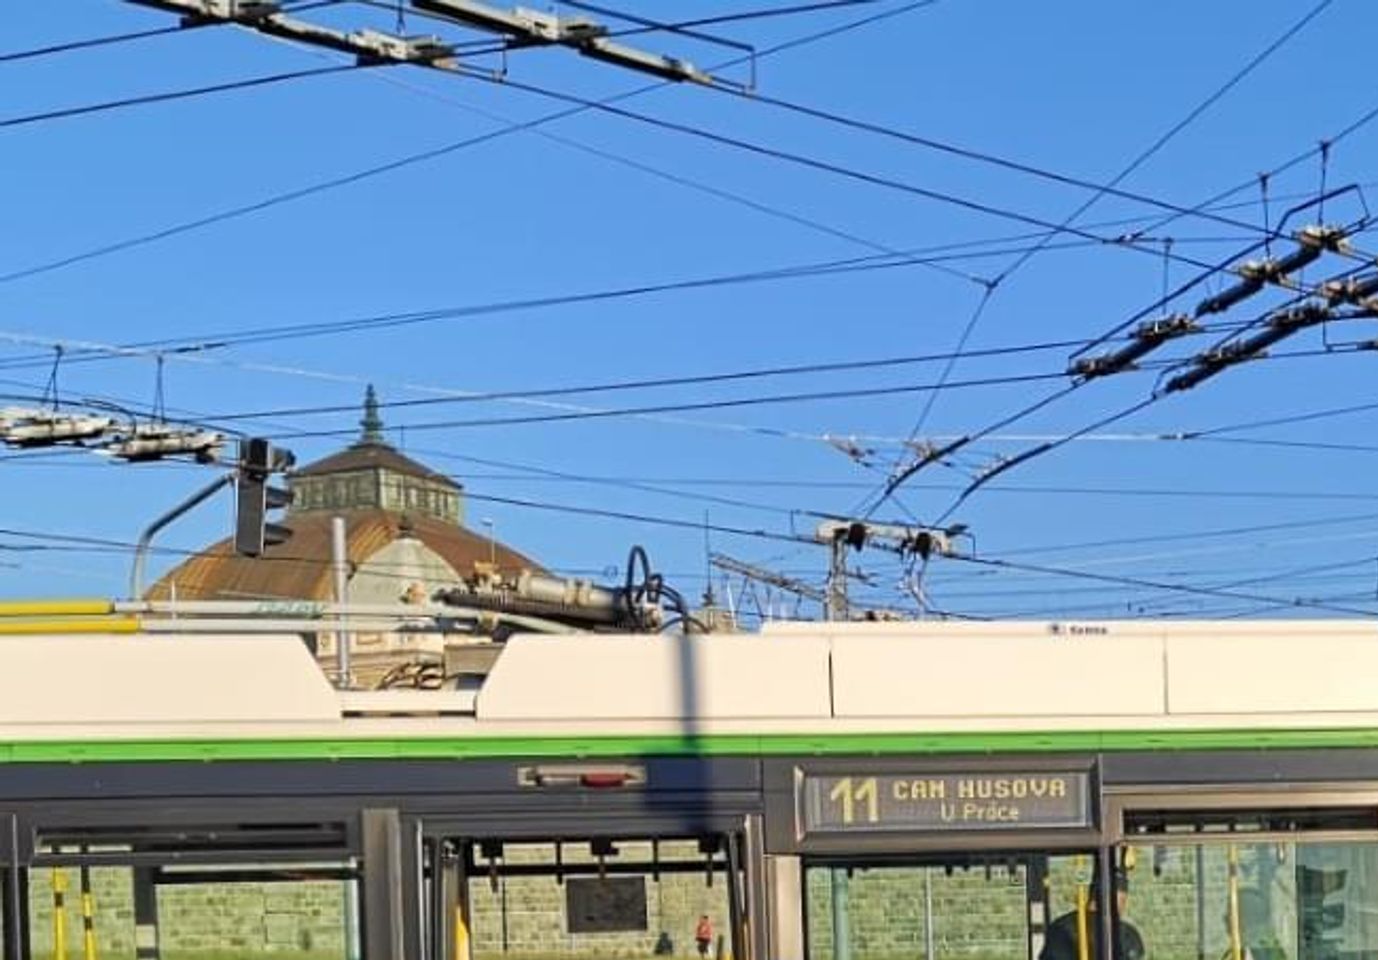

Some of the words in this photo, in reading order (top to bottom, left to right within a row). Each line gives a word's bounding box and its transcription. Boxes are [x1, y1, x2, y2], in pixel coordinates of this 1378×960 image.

[830, 777, 878, 823] 11
[957, 778, 1066, 799] HUSOVA
[940, 801, 955, 821] U
